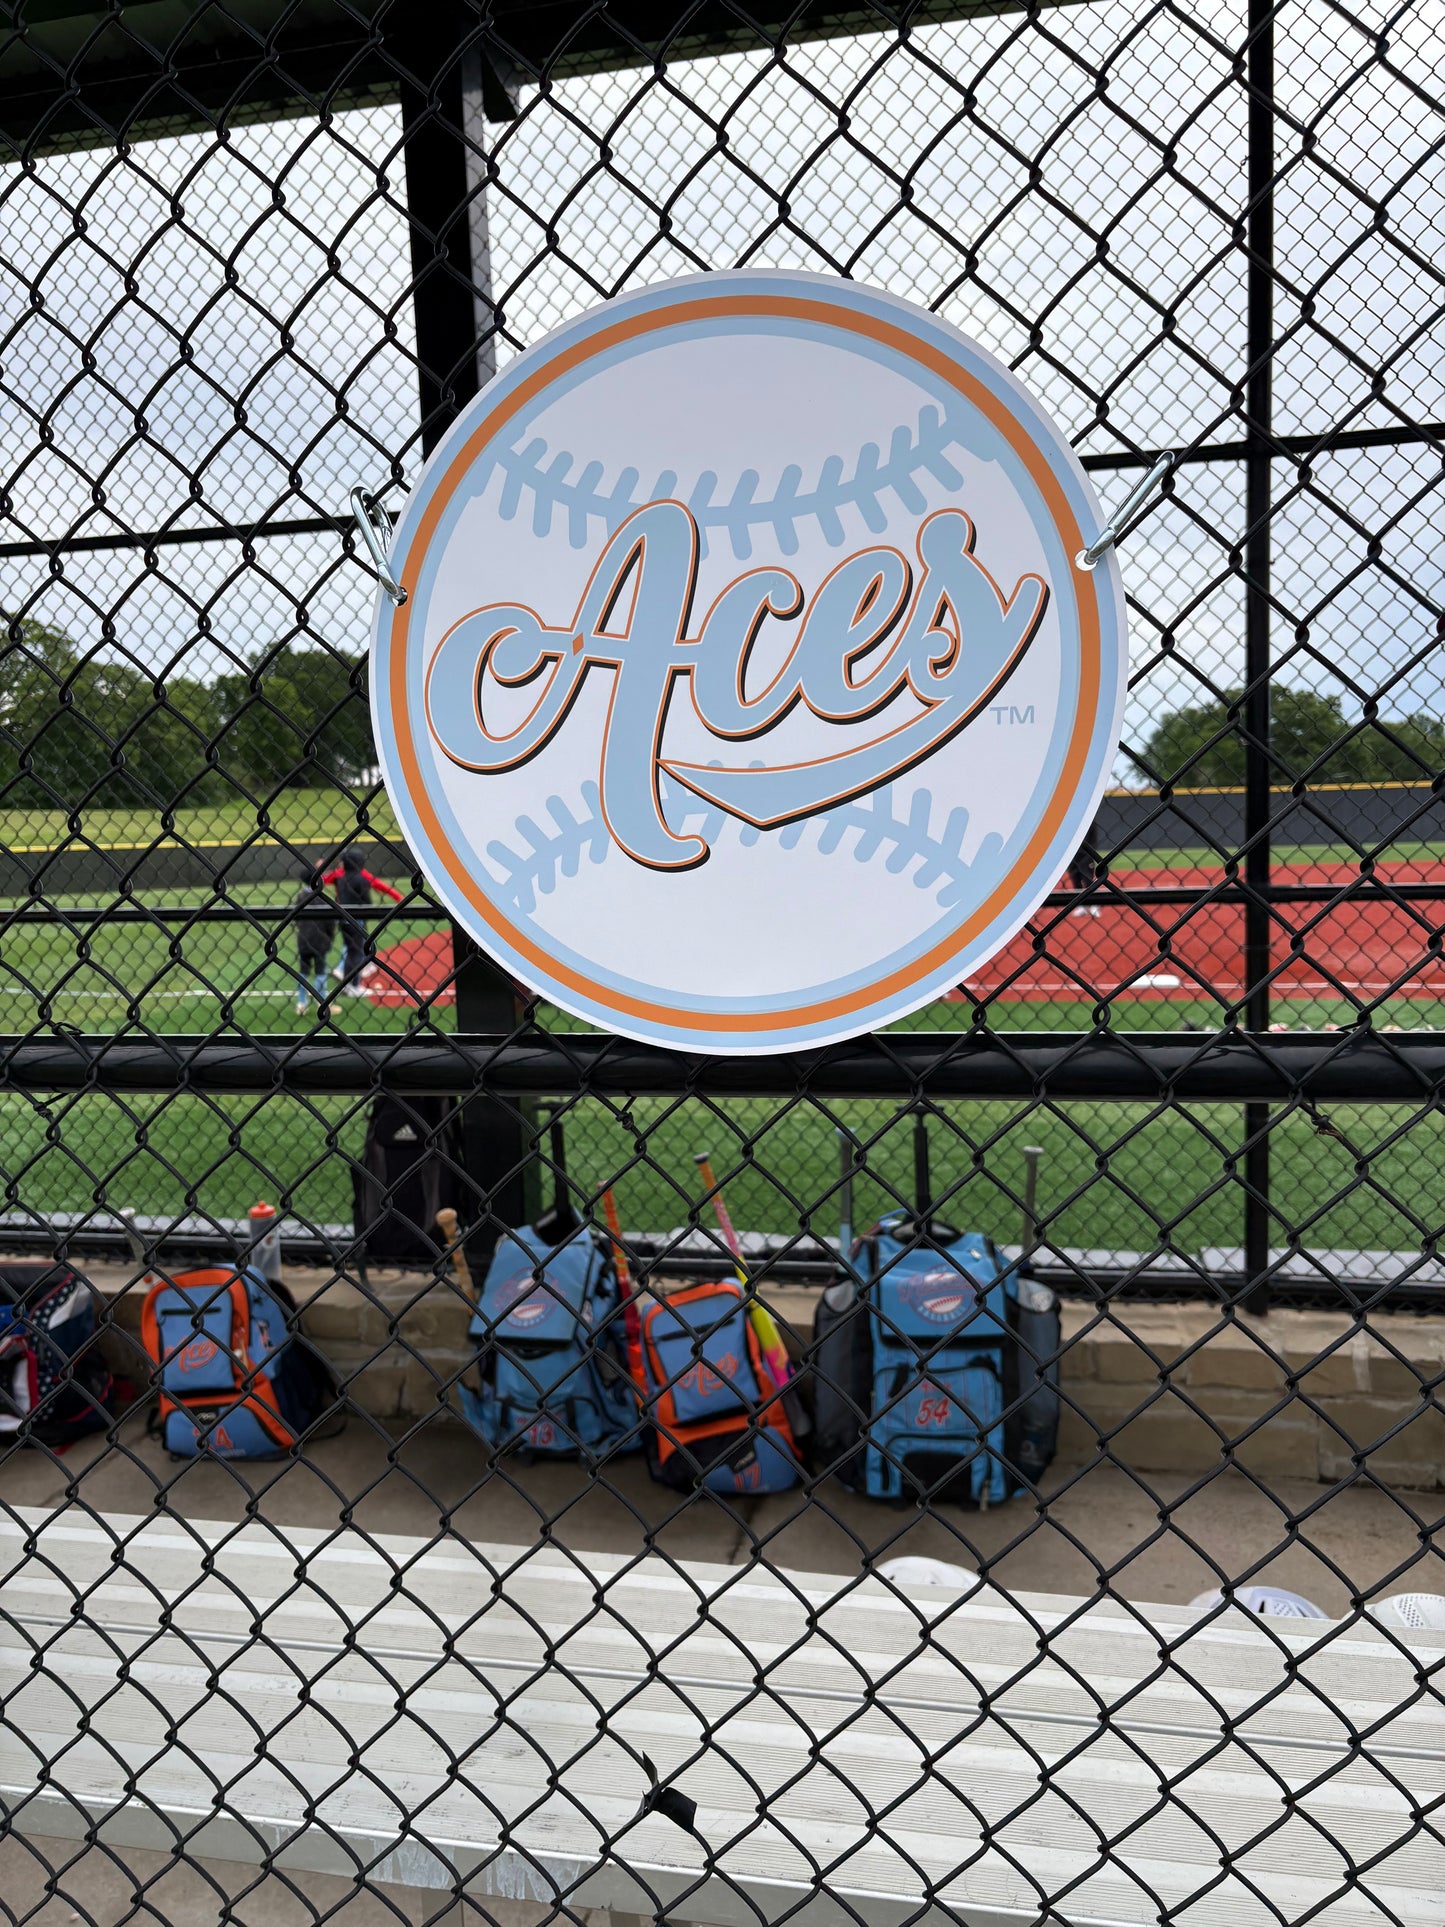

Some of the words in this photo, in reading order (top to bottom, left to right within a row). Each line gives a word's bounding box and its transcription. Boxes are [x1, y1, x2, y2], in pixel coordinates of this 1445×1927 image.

[425, 498, 1050, 873] Aces
[990, 705, 1035, 725] TM
[915, 1397, 951, 1426] 54
[528, 1422, 553, 1447] 13
